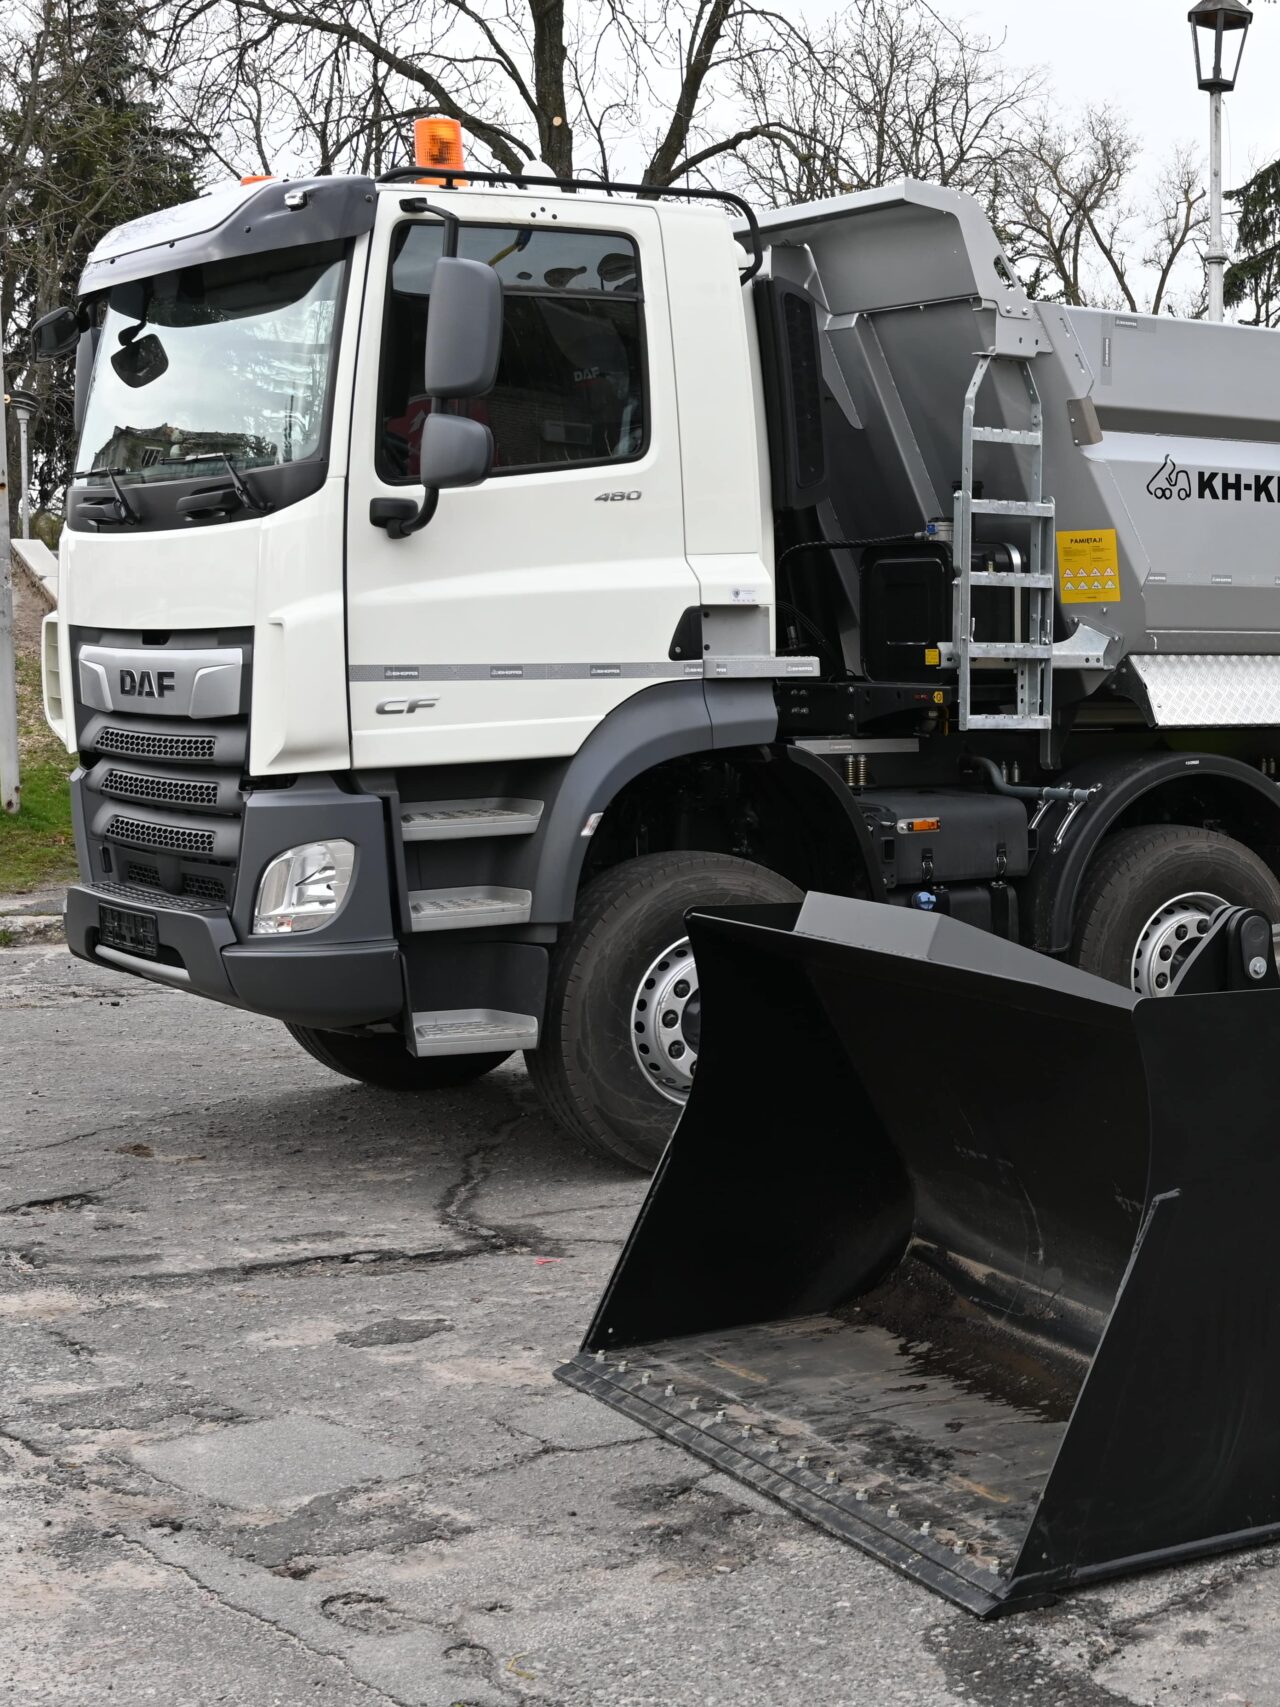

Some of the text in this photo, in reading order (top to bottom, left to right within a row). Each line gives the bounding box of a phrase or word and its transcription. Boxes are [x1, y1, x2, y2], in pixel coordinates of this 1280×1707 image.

[574, 367, 600, 381] DAF
[594, 490, 642, 502] 480
[119, 669, 175, 699] DAF
[375, 696, 441, 715] CF
